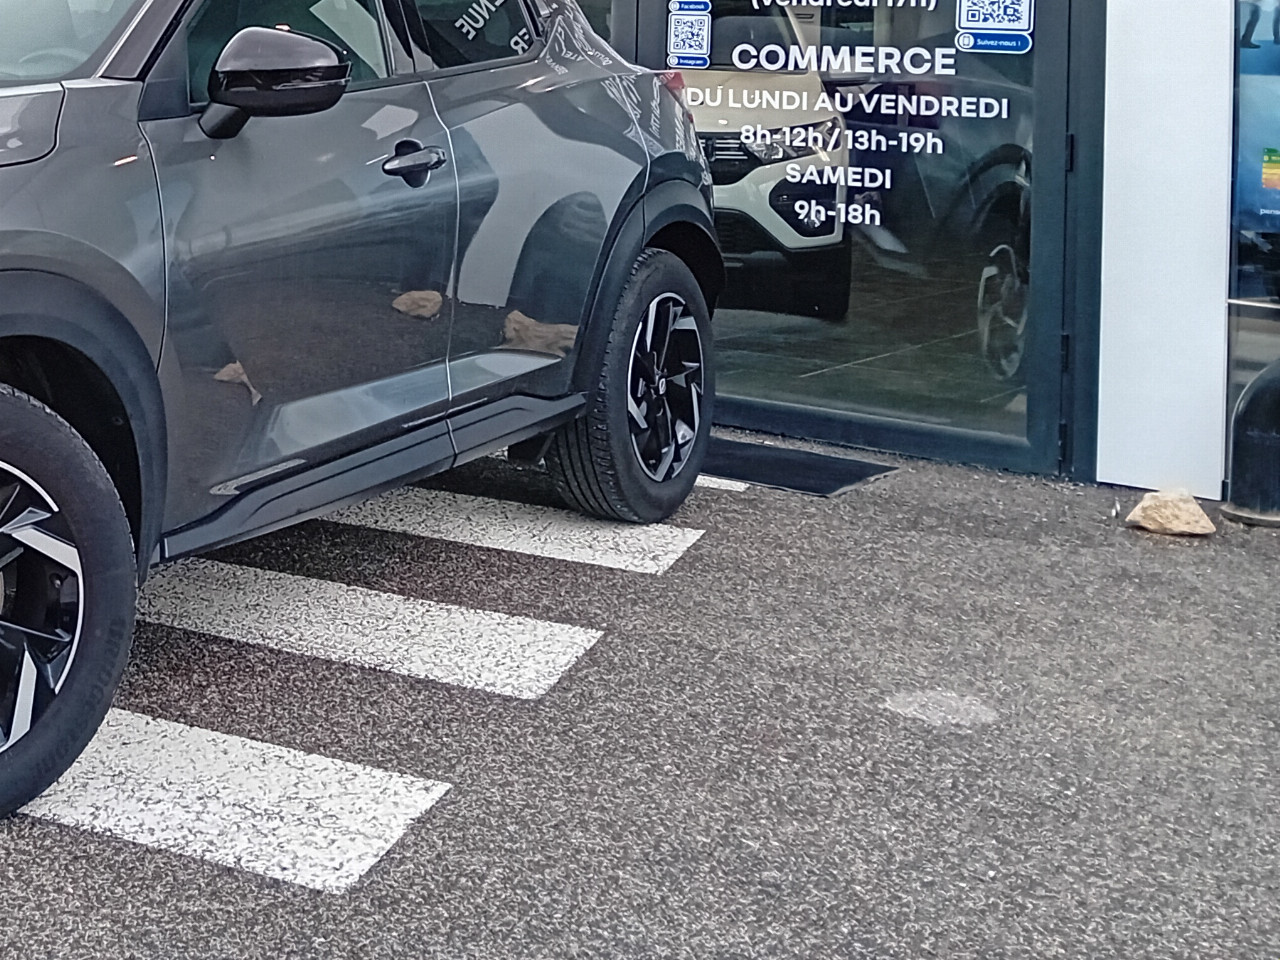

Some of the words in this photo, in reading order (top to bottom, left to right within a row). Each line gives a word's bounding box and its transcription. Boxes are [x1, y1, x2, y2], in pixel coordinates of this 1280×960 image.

[732, 43, 956, 75] COMMERCE
[686, 87, 721, 106] DU
[728, 89, 808, 111] LUNDI
[814, 92, 853, 112] AU
[859, 94, 1008, 119] VENDREDI
[740, 125, 823, 148] 8h-12h
[844, 130, 944, 154] 13h-19h
[785, 163, 891, 189] SAMEDI
[794, 200, 880, 225] 9h-18h
